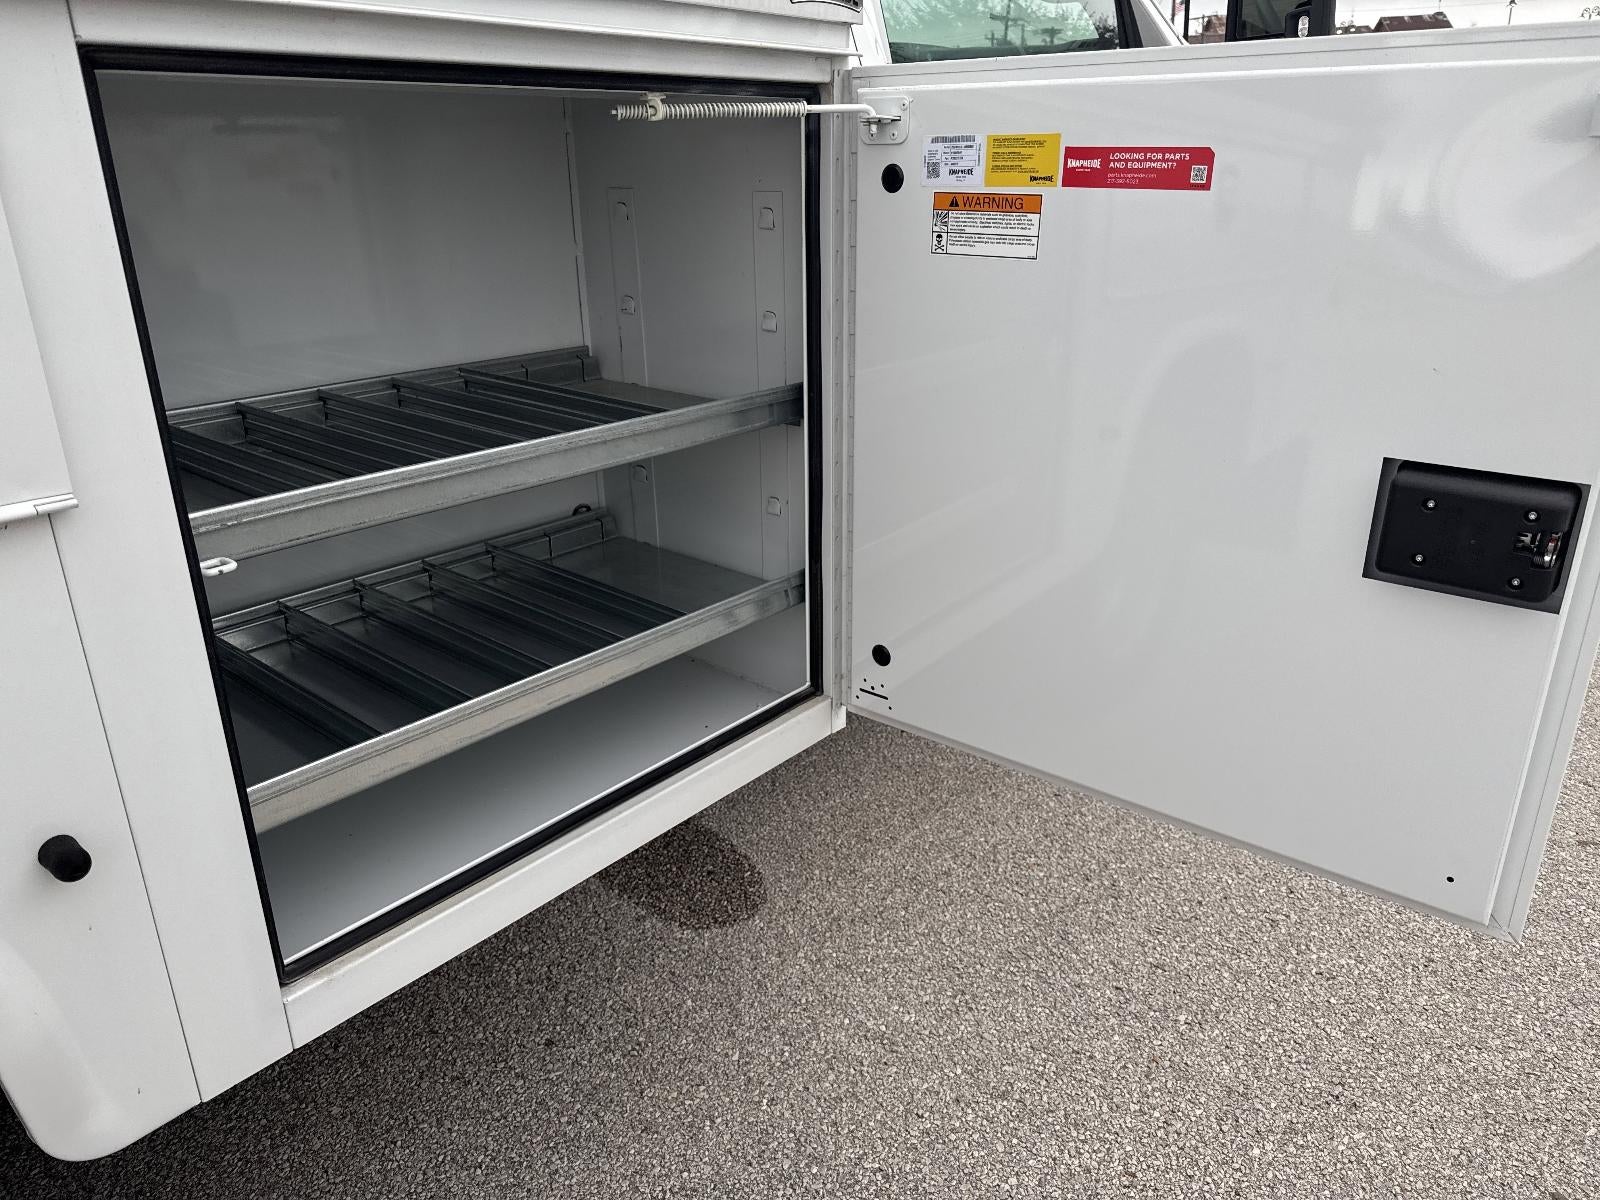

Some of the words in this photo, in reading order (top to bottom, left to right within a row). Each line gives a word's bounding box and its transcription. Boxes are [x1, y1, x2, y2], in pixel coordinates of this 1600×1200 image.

[1110, 152, 1145, 160] LOOKING
[1067, 158, 1101, 169] KNAPHEIDE
[1109, 161, 1126, 169] AND
[1127, 161, 1177, 169] EQUIPMENT?
[962, 196, 1024, 210] WARNING
